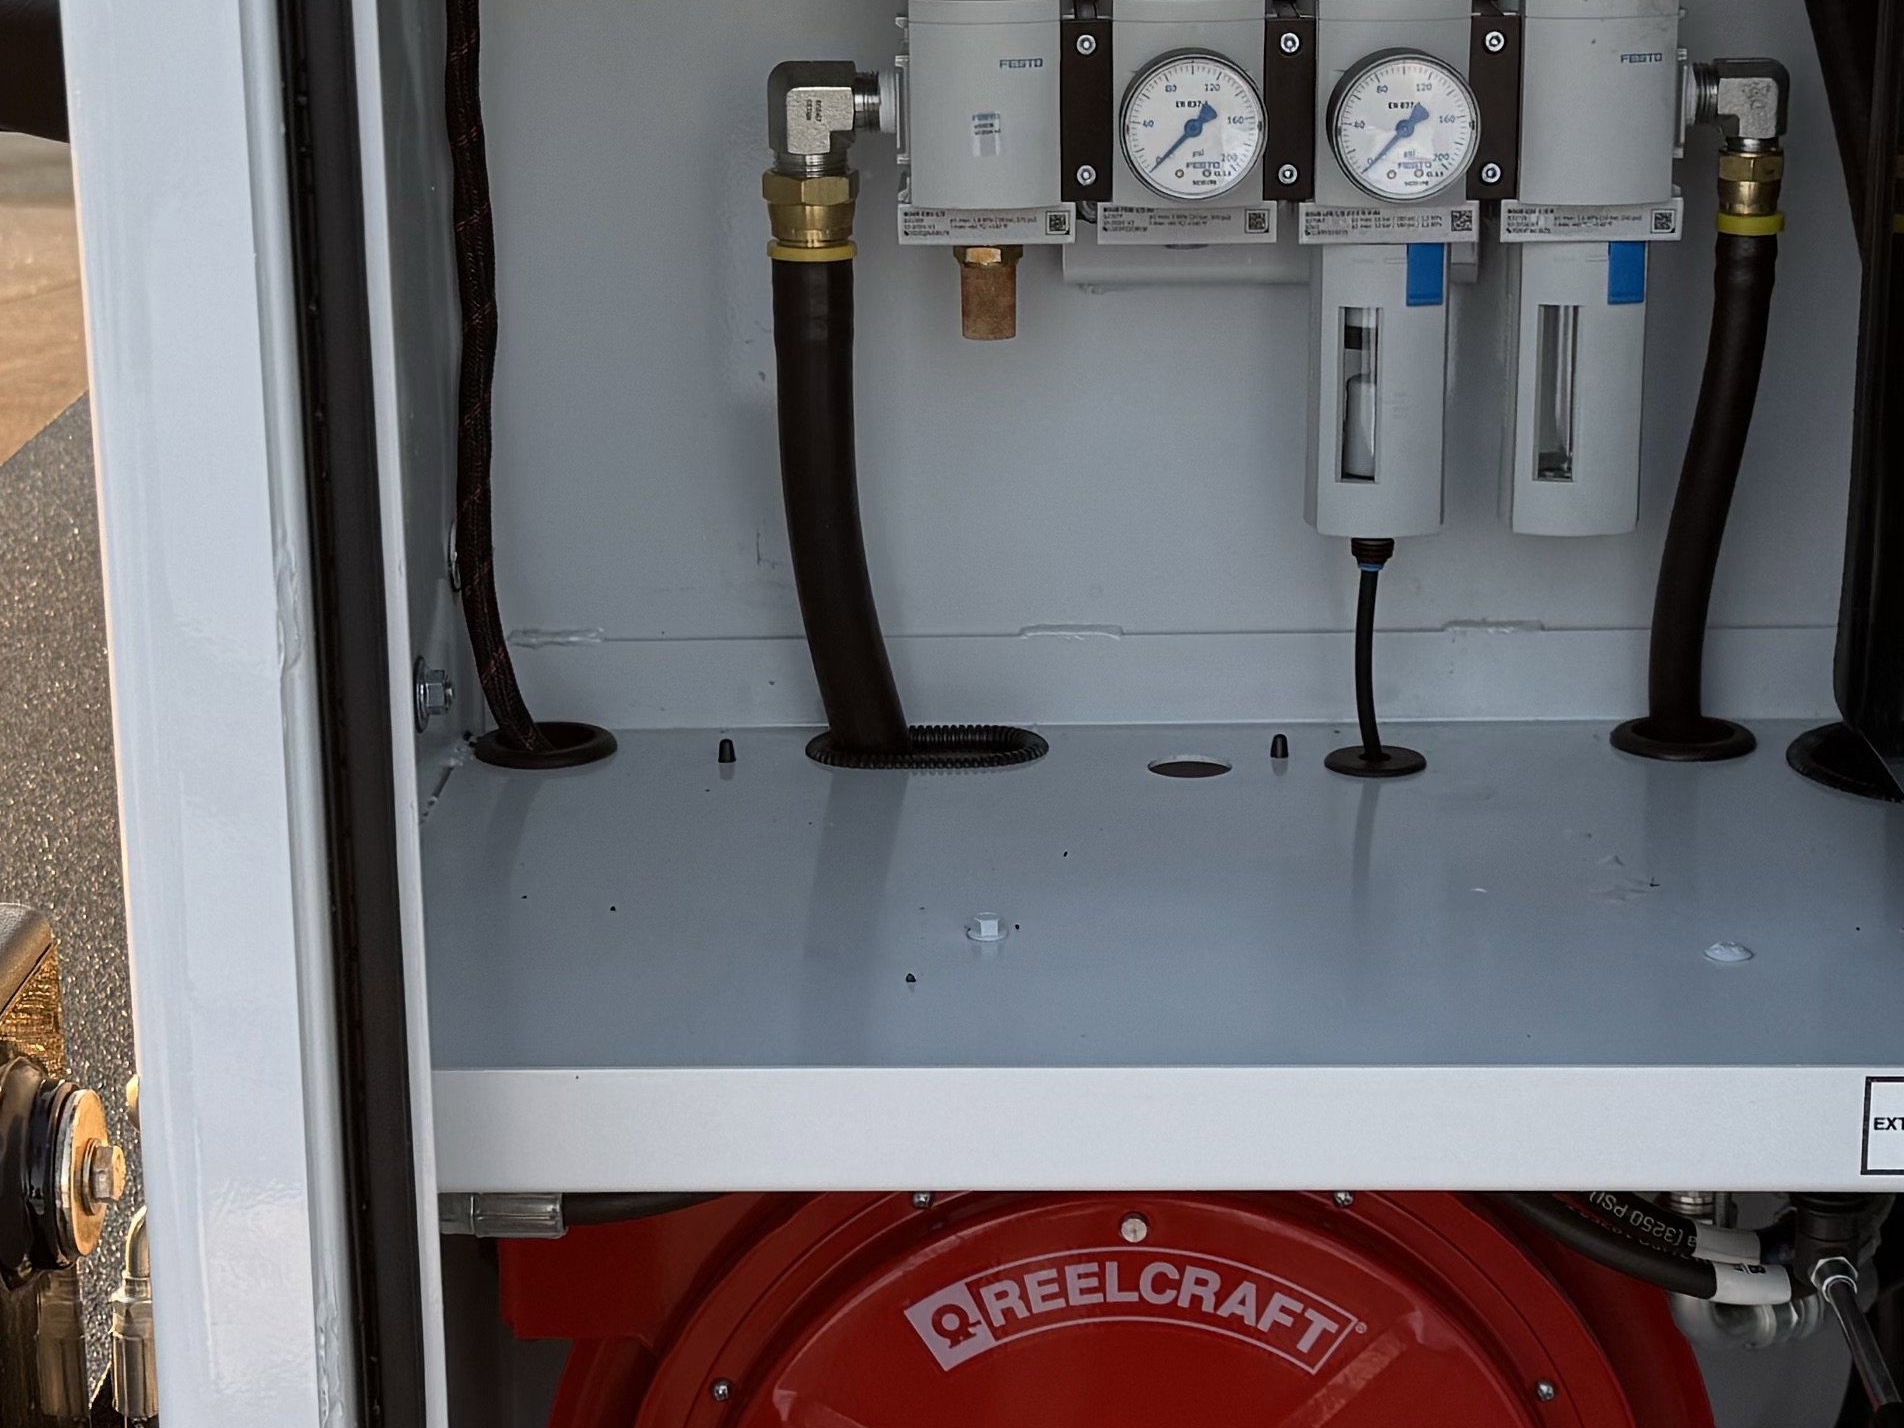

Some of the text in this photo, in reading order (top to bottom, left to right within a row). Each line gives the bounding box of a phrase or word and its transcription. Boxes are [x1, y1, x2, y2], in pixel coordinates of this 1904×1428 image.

[1620, 53, 1662, 63] FESTO
[999, 58, 1043, 69] FESTO
[1204, 83, 1220, 92] 120
[1416, 83, 1432, 92] 120
[1227, 116, 1244, 125] 160
[1439, 115, 1456, 124] 160
[1186, 161, 1220, 169] FESTO
[1398, 161, 1432, 169] FESTO
[1630, 1210, 1684, 1246] (3250
[978, 1261, 1339, 1355] REELCRAFT
